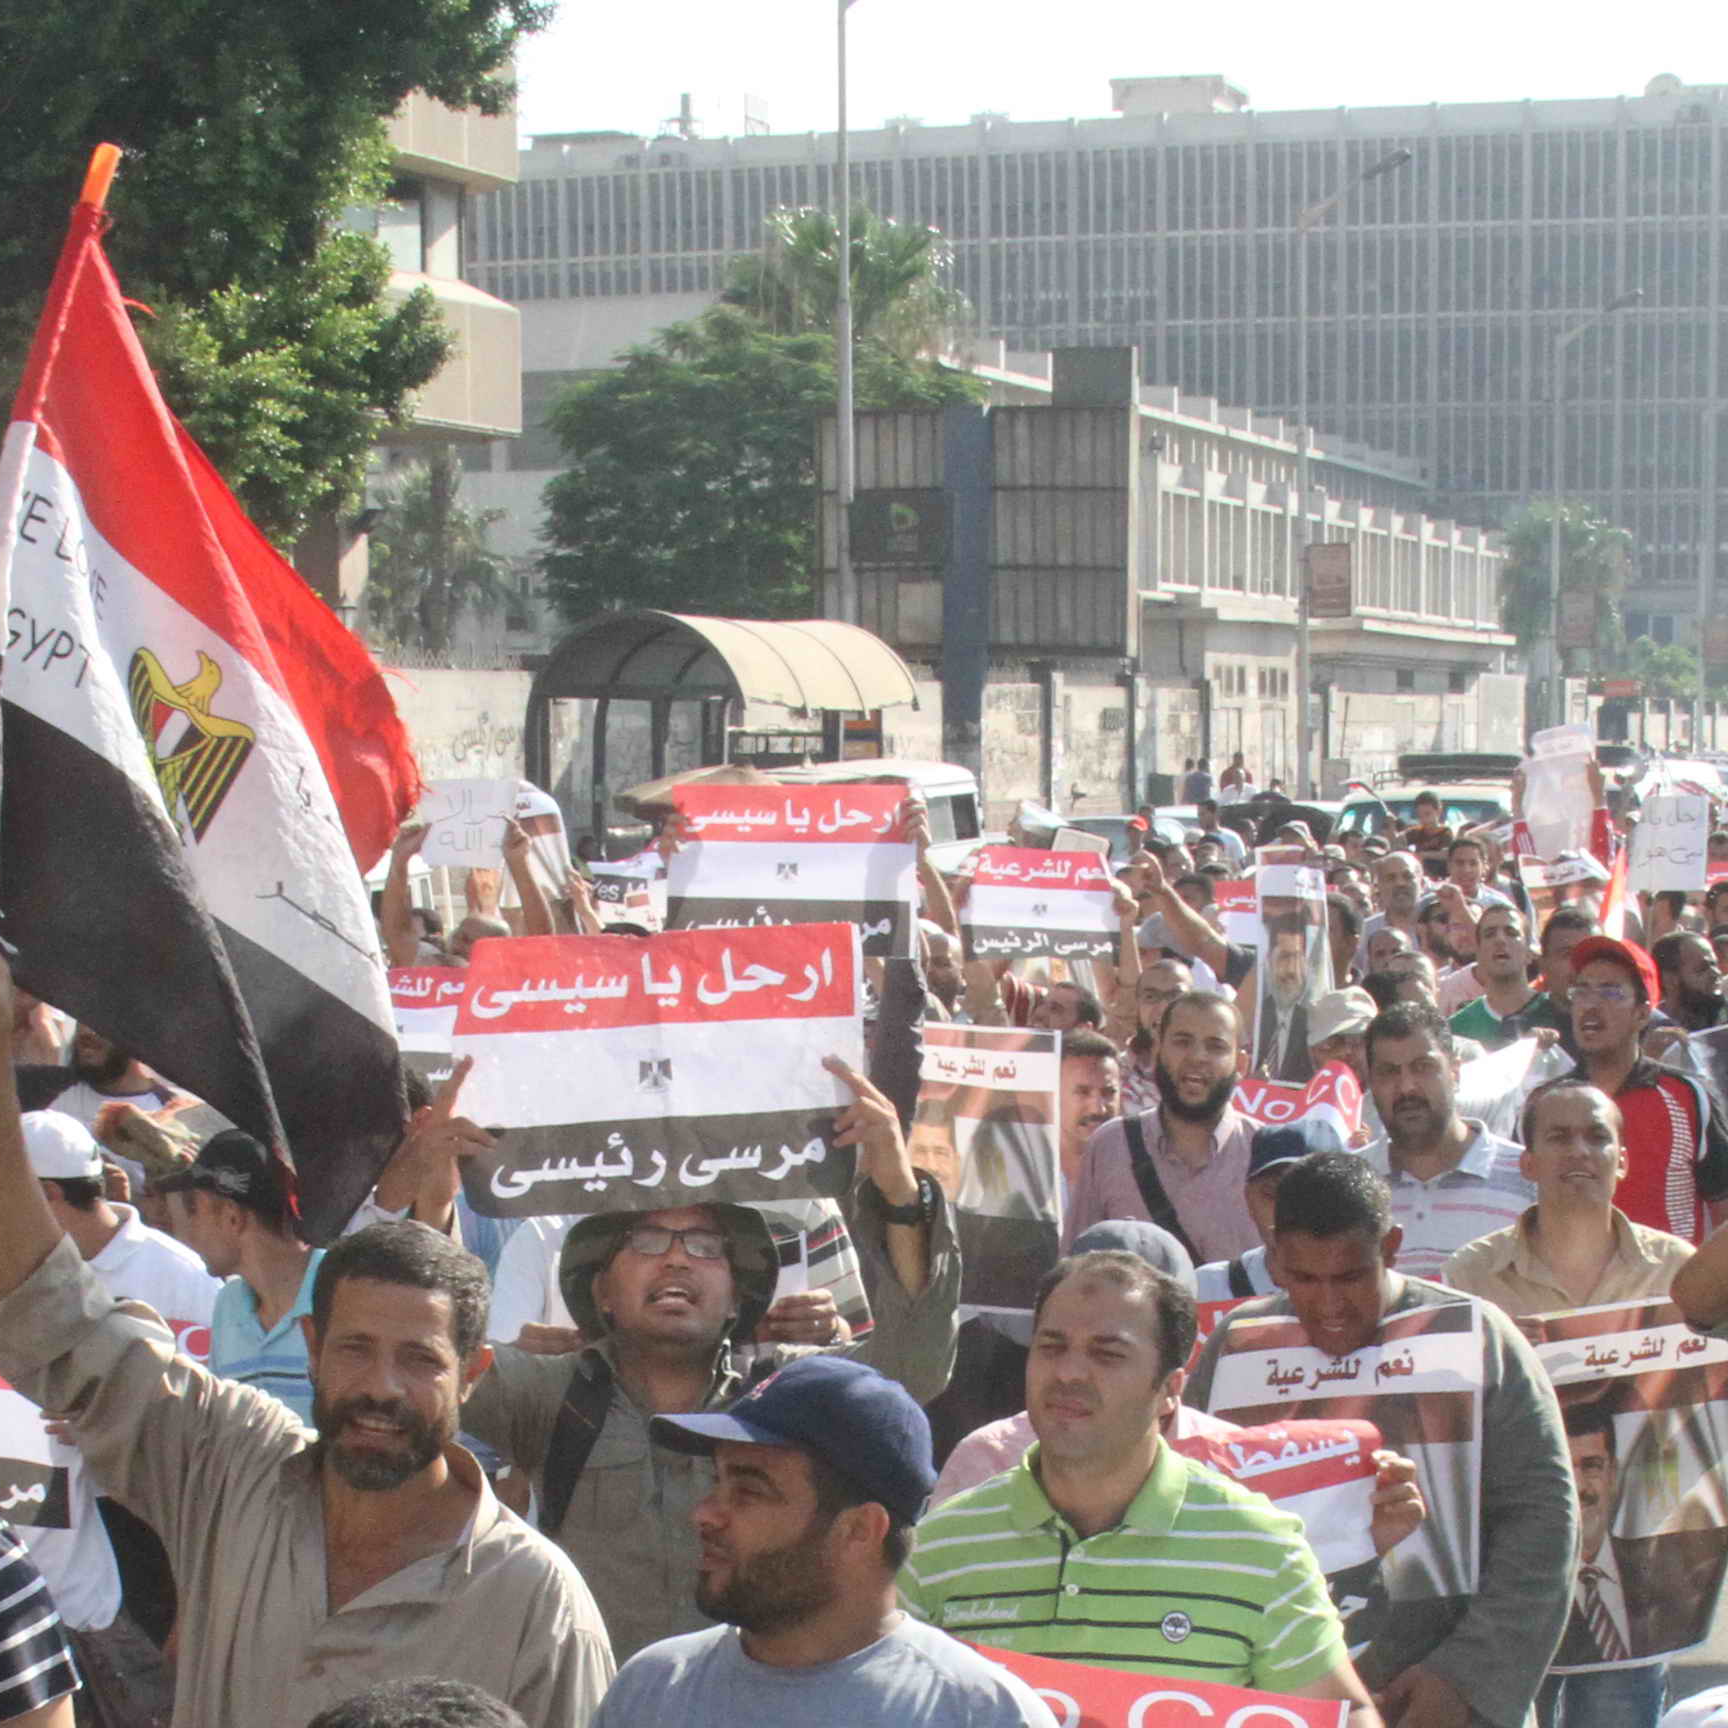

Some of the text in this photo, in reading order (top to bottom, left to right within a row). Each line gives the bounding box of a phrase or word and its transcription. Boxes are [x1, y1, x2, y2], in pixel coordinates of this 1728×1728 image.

[19, 490, 54, 545] E
[684, 798, 901, 834] ارحل يا سيسى
[470, 970, 630, 1020] سيسى
[640, 951, 683, 1008] يا
[696, 947, 833, 1006] ارحل
[490, 1131, 827, 1200] مرسى رئيسى
[1265, 1348, 1415, 1396] نعم للشرعية
[1584, 1335, 1666, 1374] للشرعية
[1228, 1428, 1361, 1480] يسقط
